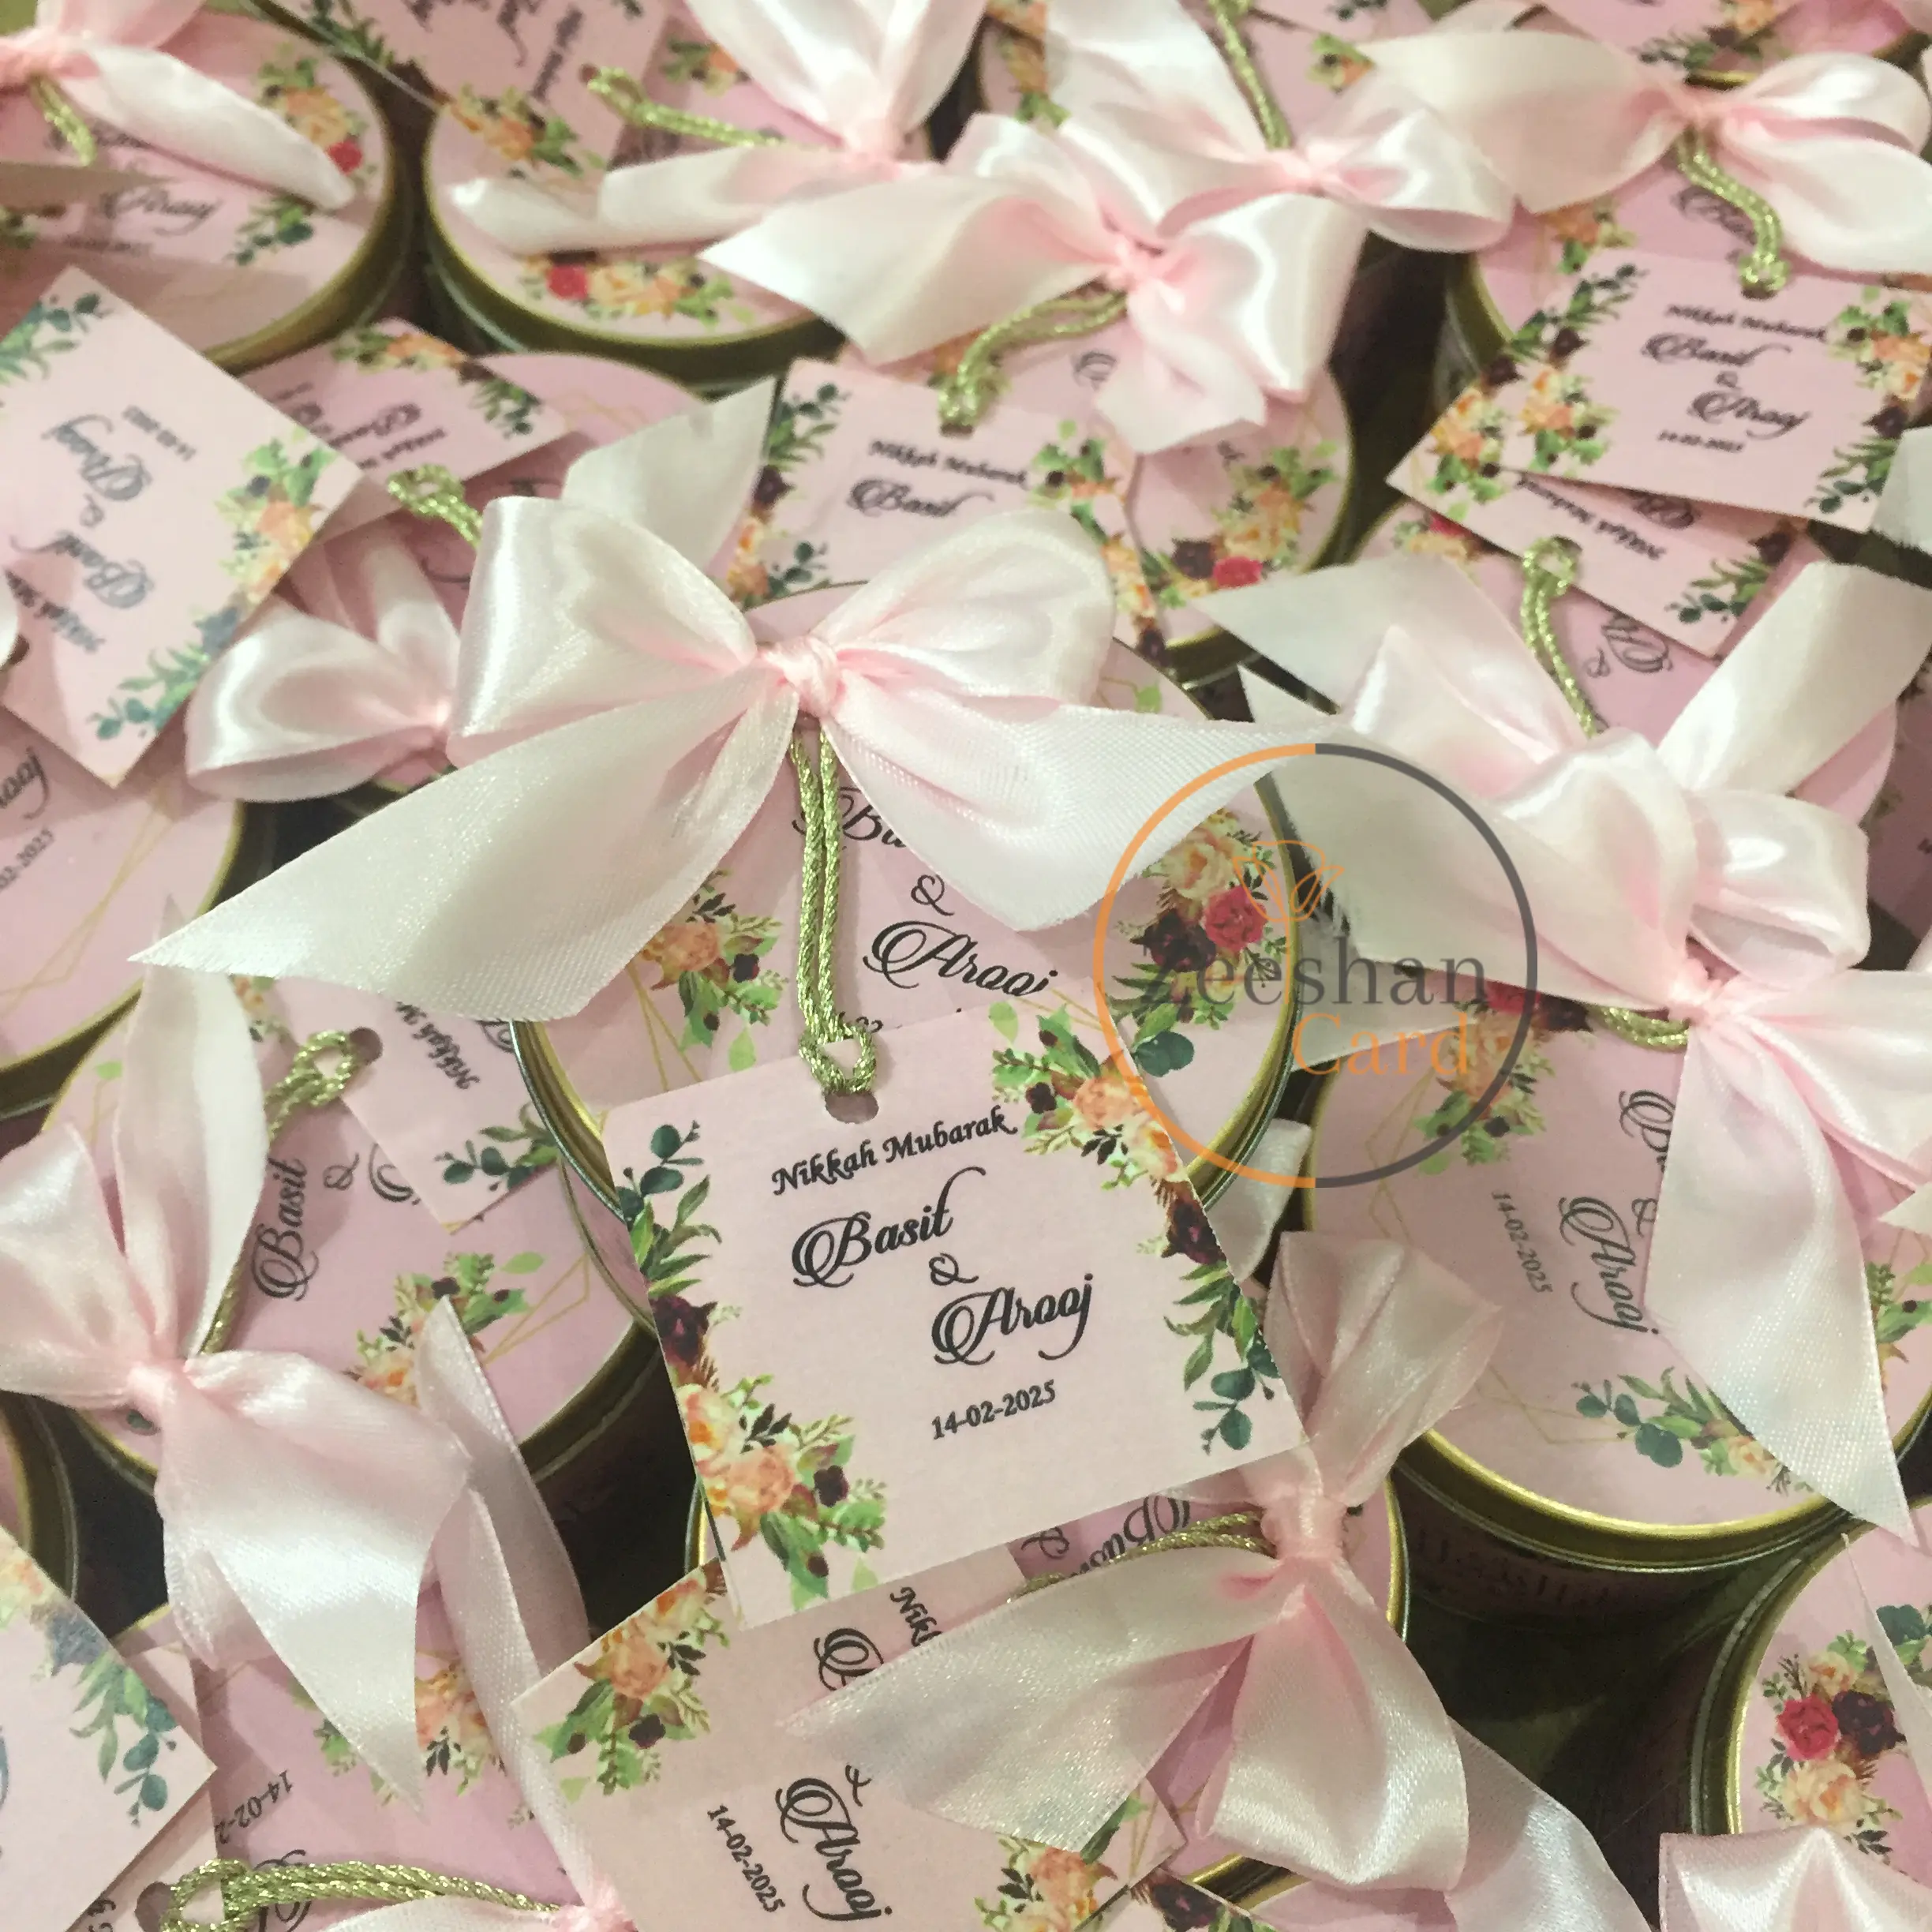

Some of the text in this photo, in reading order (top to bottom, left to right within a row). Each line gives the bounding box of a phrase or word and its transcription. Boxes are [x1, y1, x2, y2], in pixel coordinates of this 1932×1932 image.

[911, 874, 955, 917] &
[323, 1152, 360, 1191] &
[771, 1104, 1018, 1196] Nikkah Mubarak
[791, 1166, 987, 1289] Basit
[928, 1252, 979, 1286] &
[1492, 1191, 1554, 1293] 14-02-2025
[1558, 1196, 1660, 1335] Arooj
[930, 1272, 1095, 1366] Arooj
[931, 1378, 1057, 1440] 14-02-2025
[215, 1769, 294, 1845] 14-02-2
[775, 1777, 893, 1923] Arooj
[706, 1803, 787, 1913] 14-02-2025
